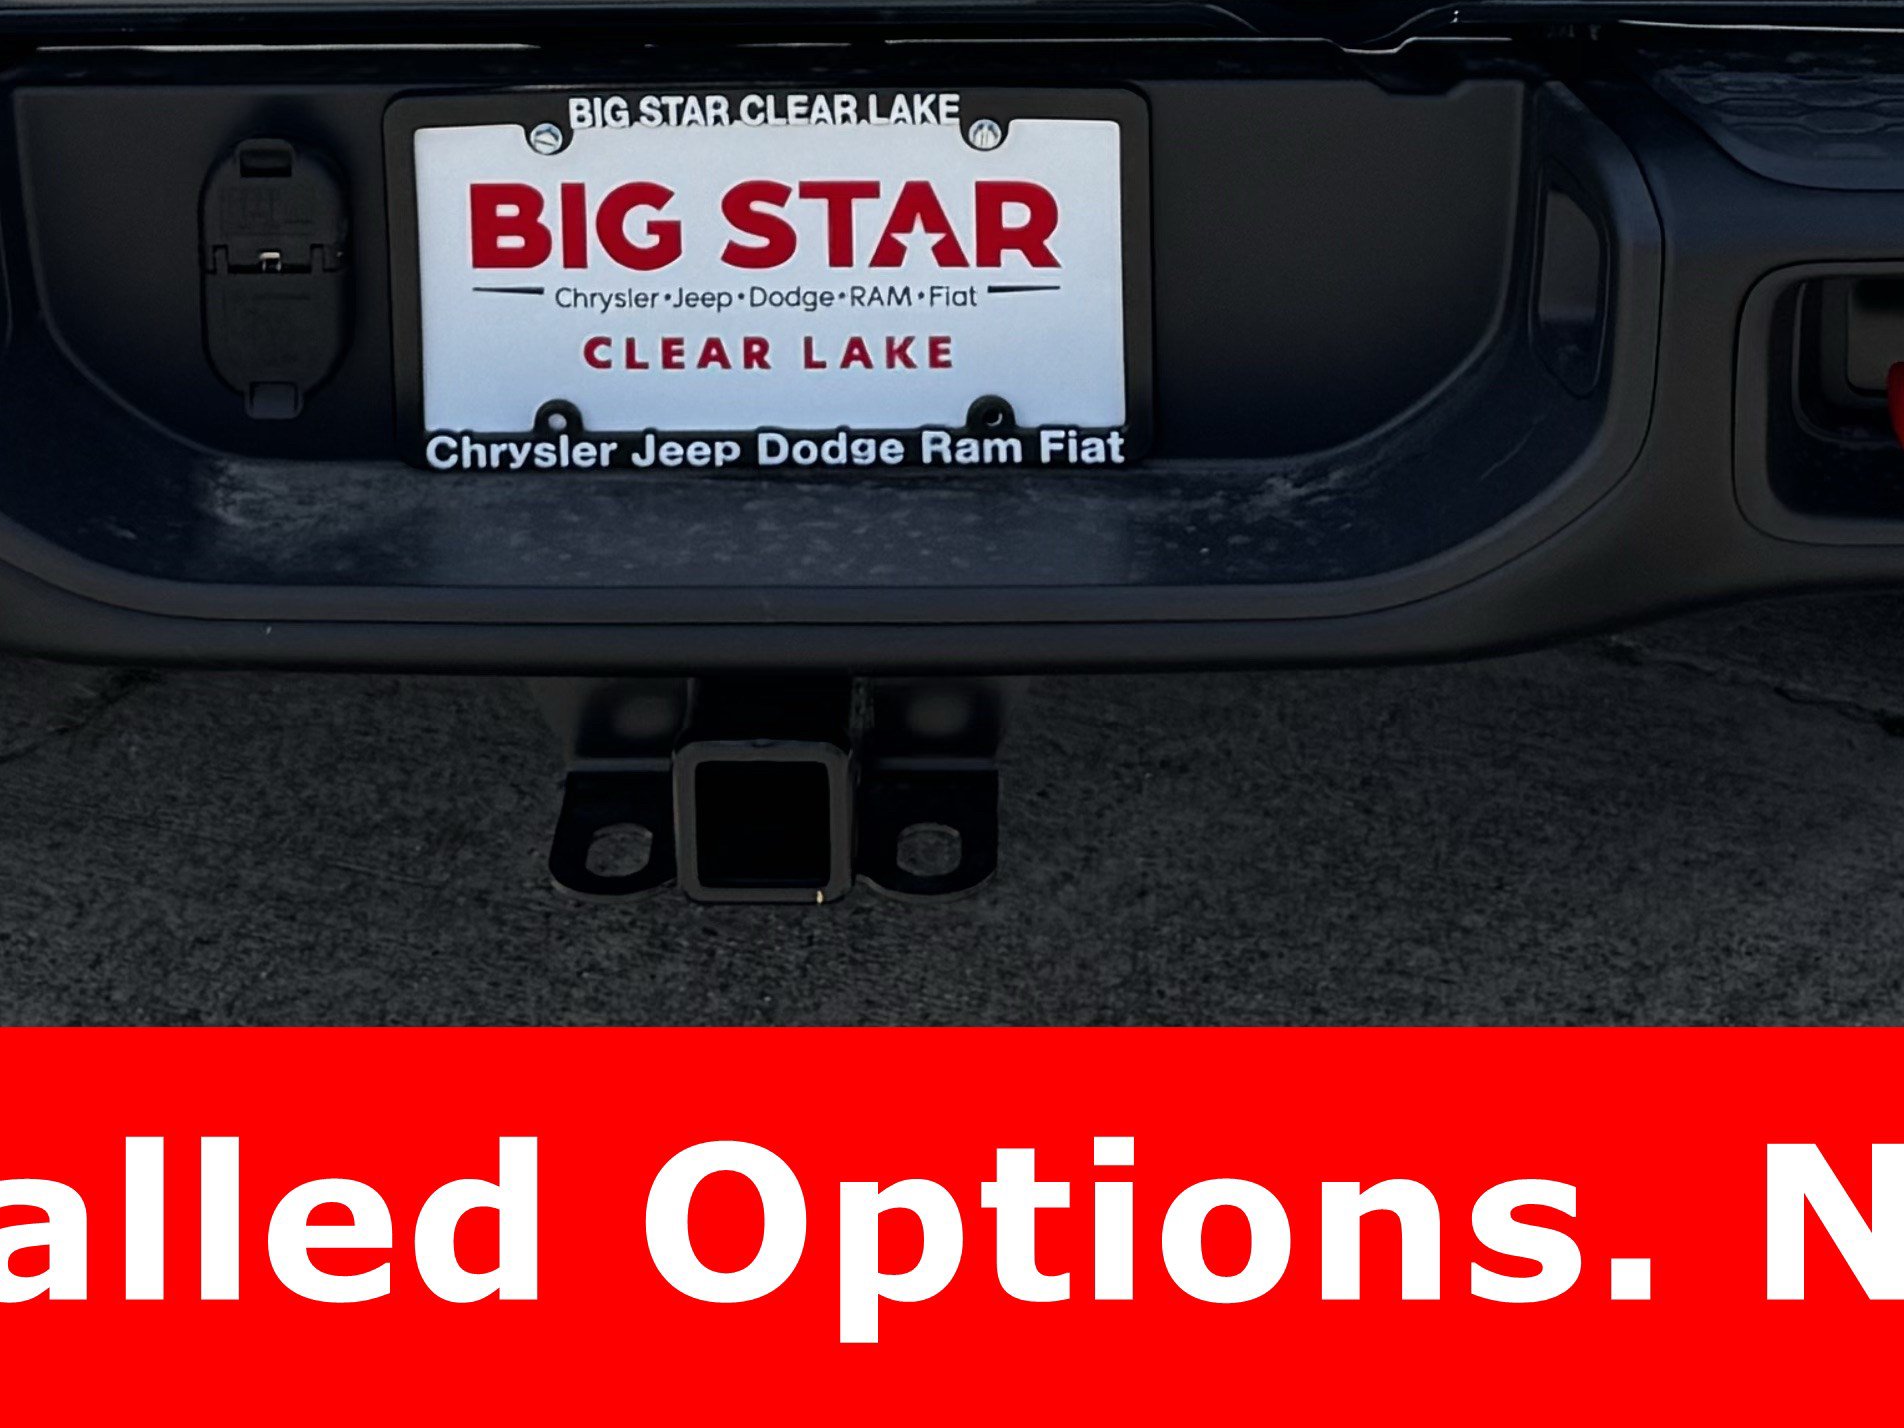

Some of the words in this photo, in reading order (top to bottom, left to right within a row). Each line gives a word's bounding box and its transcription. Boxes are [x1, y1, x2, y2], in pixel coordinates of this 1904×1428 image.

[568, 96, 631, 129] BIG
[639, 95, 730, 128] STAR
[739, 94, 859, 127] CLEAR
[868, 93, 960, 126] LAKE
[469, 182, 682, 271] BIG
[721, 180, 1061, 270] STAR
[583, 336, 772, 370] CLEAR
[804, 336, 954, 370] LAKE
[426, 434, 618, 471] Chrysler
[631, 433, 741, 469] Jeep
[757, 432, 906, 467] Dodge
[921, 430, 1023, 464] Ram
[1040, 430, 1125, 464] Fiat
